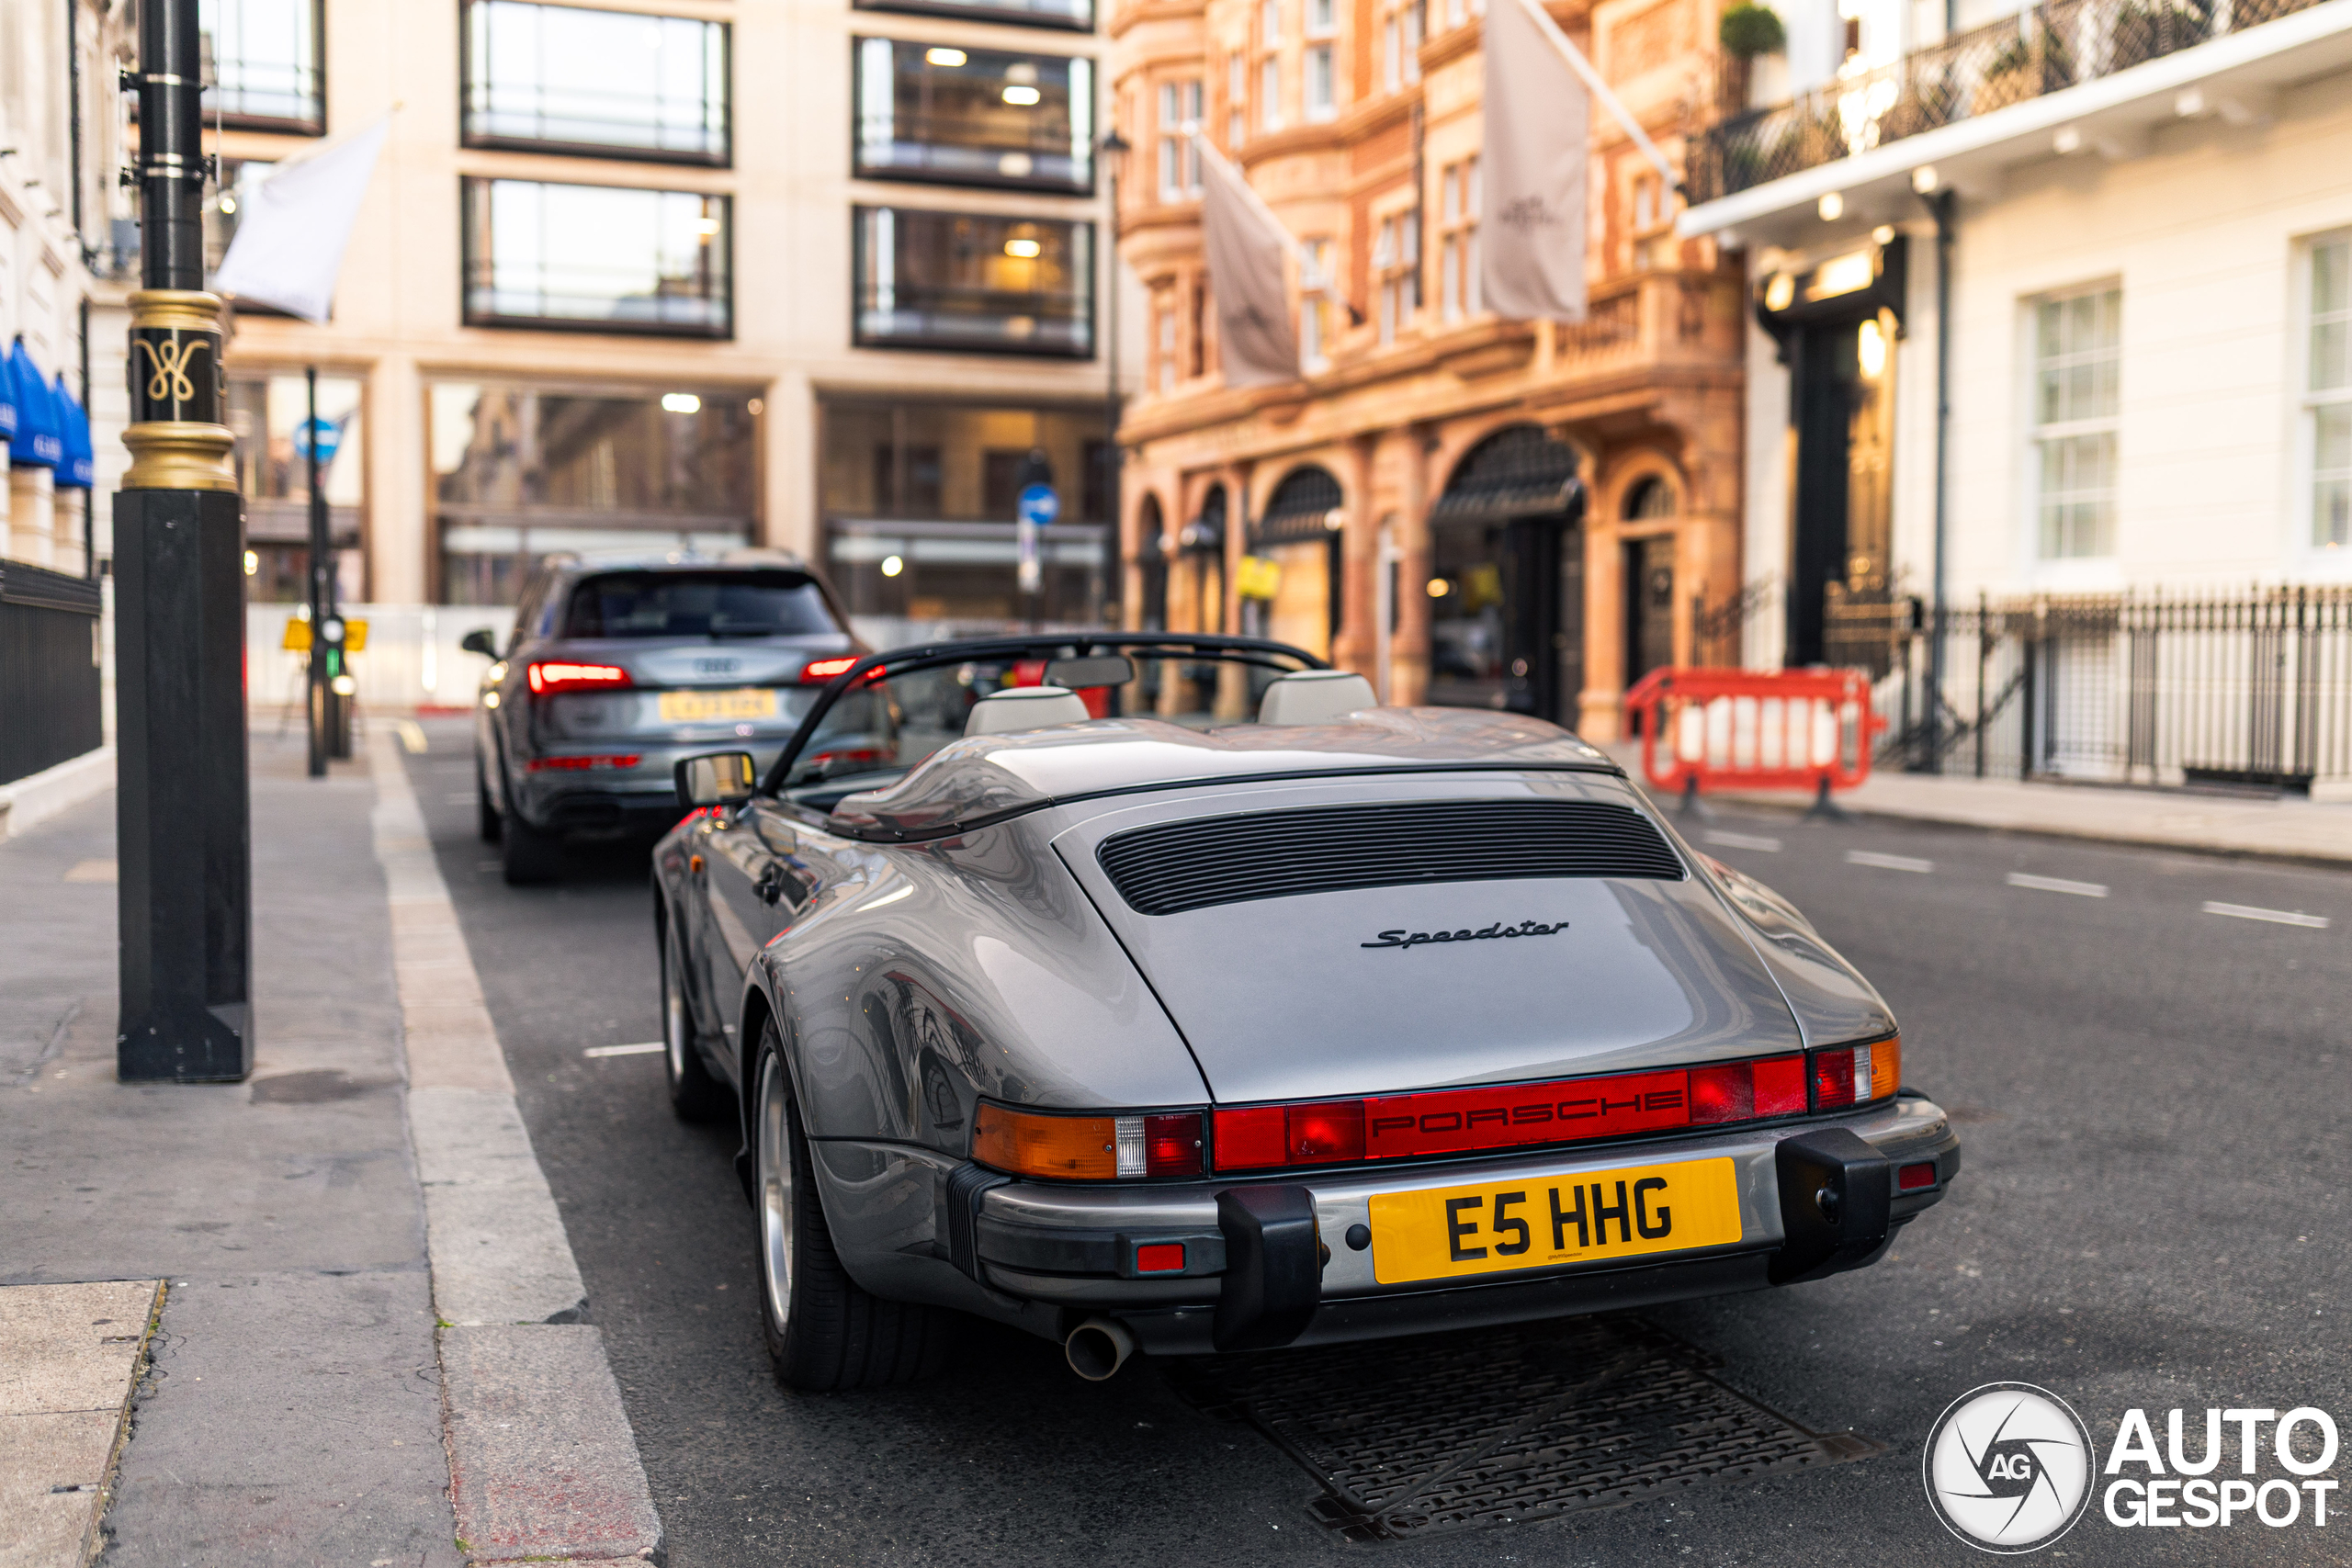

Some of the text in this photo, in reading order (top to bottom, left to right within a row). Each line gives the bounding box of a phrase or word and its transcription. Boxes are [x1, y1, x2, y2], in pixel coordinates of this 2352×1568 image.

[1361, 919, 1569, 949] Speedster
[1372, 1089, 1683, 1138] PORSCHE
[1445, 1176, 1672, 1263] E5 HHG
